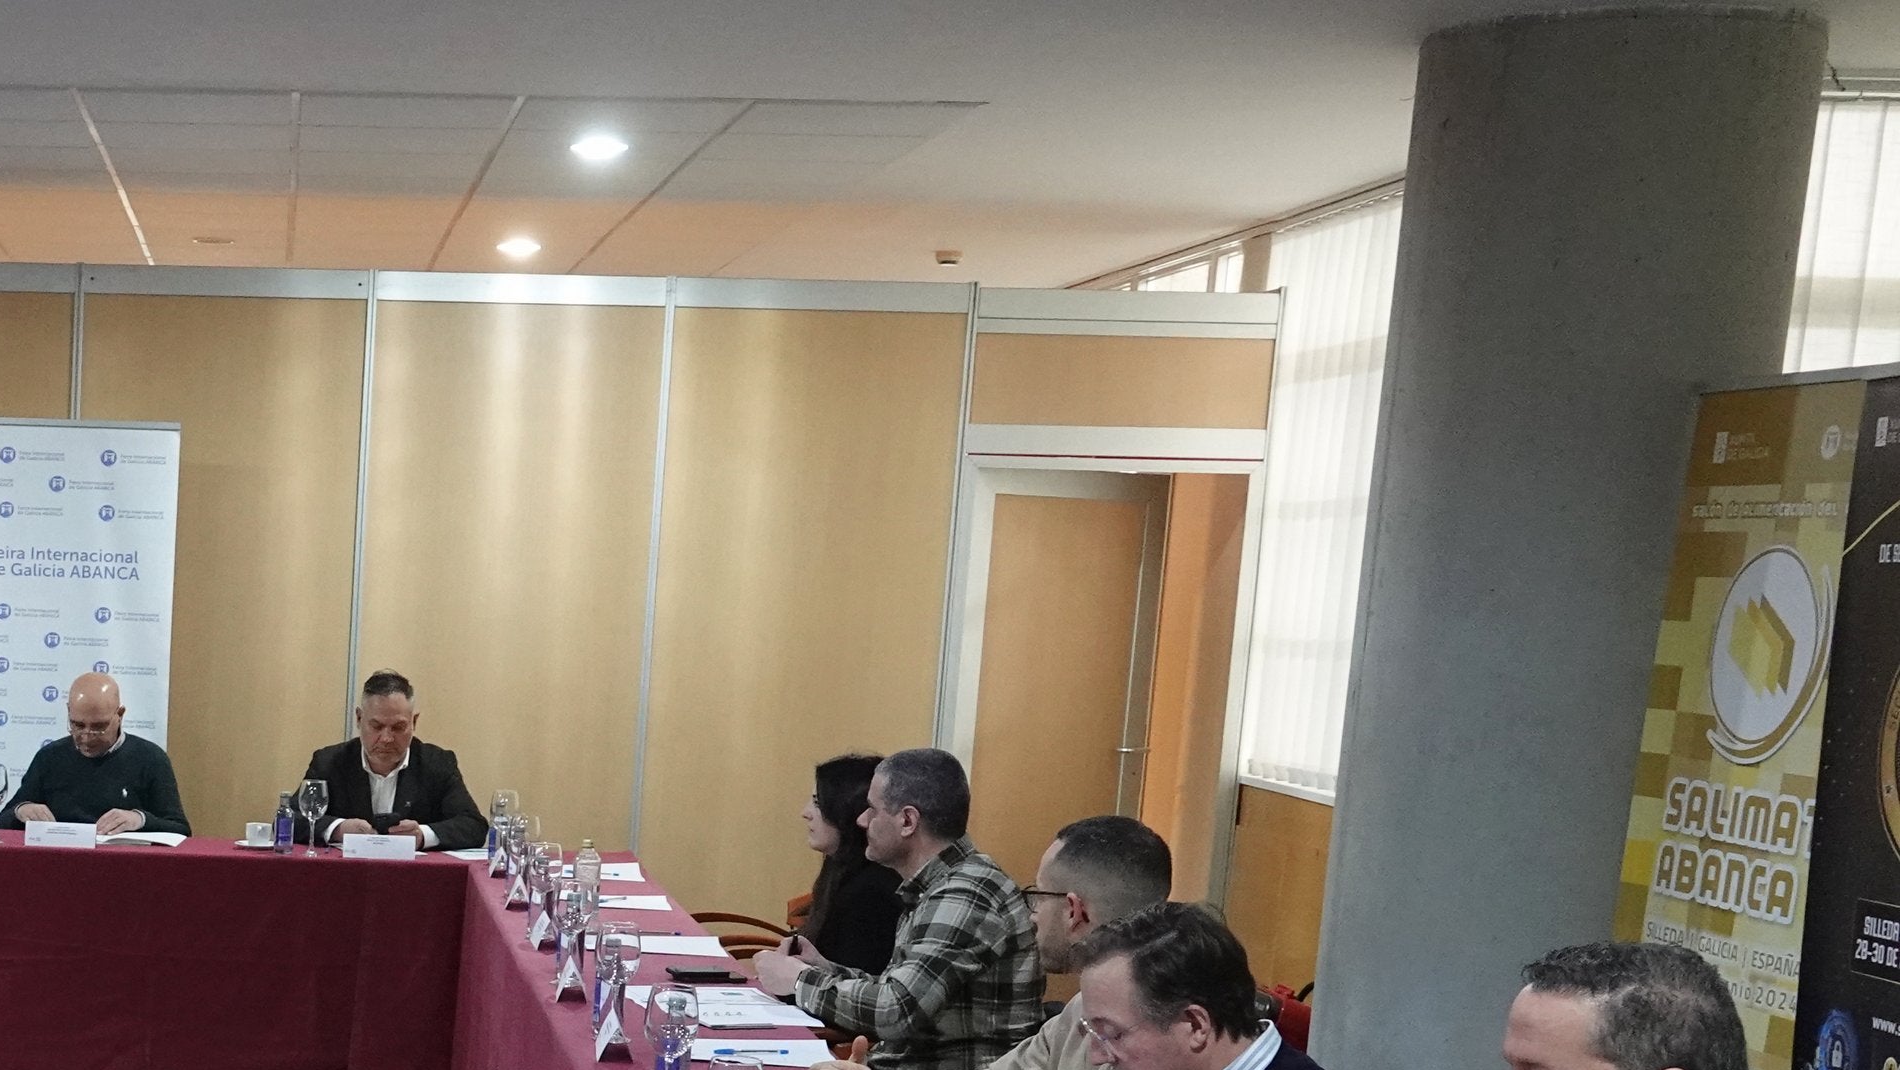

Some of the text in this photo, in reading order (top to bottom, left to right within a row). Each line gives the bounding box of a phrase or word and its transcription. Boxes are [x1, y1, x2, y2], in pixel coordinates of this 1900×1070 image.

[31, 548, 139, 564] Internacional
[11, 564, 65, 578] Galicia
[70, 566, 140, 581] ABANCA
[1653, 841, 1799, 925] ABANCA
[1647, 921, 1684, 947] SILLEDA
[1700, 937, 1739, 962] GALICIA
[1855, 938, 1885, 965] 28-30
